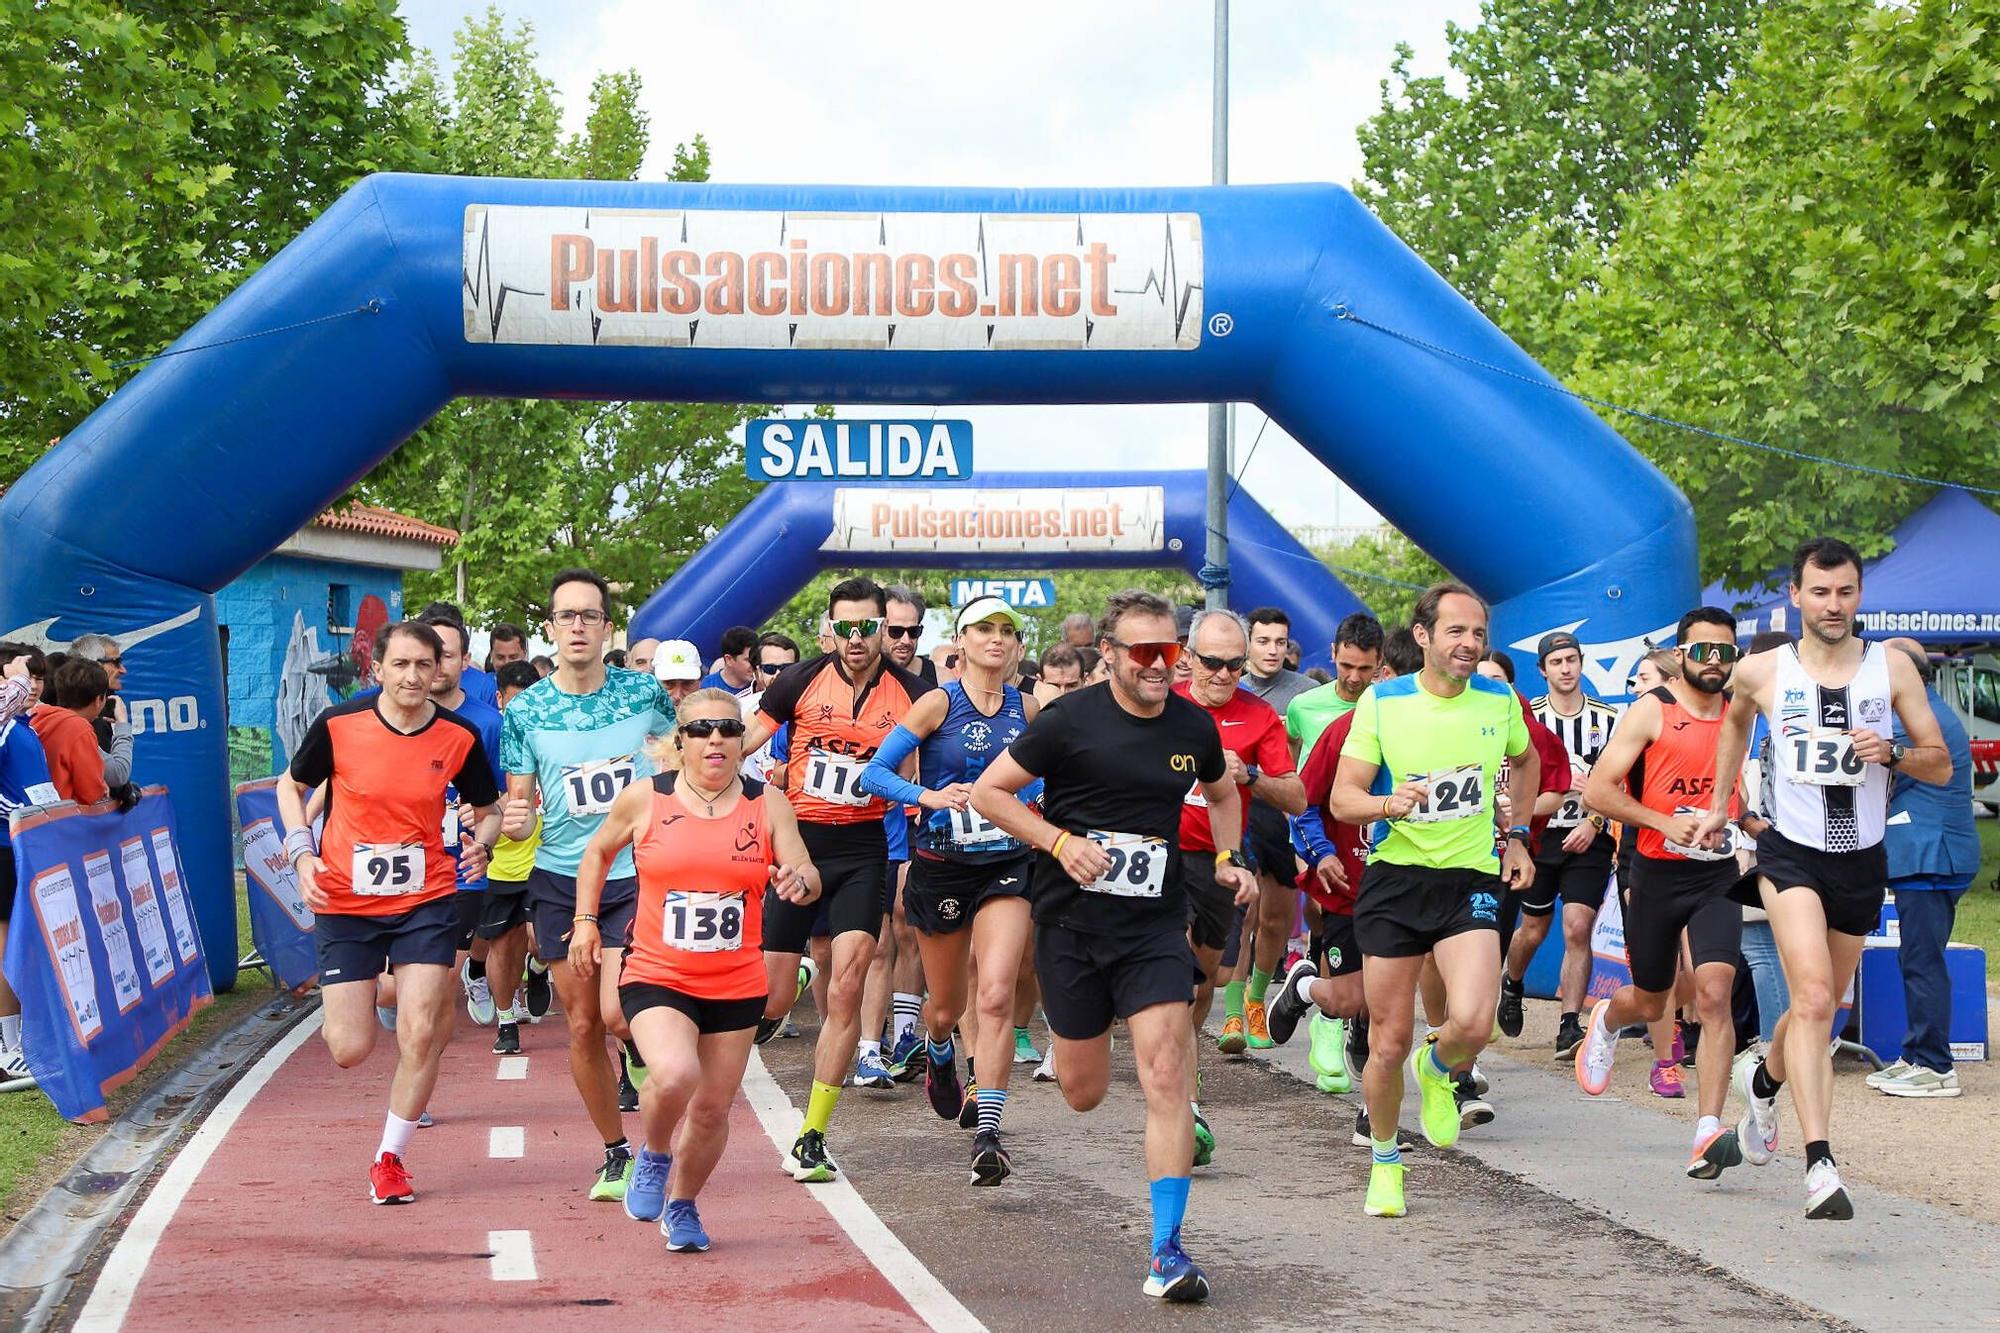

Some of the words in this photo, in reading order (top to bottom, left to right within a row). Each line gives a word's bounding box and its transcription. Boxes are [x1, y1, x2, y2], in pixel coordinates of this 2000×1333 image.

[549, 232, 1118, 319] Pulsaciones.net
[760, 422, 960, 477] SALIDA
[870, 502, 1125, 539] Pulsaciones.net
[957, 579, 1047, 606] META
[1794, 739, 1864, 776] 136
[570, 768, 632, 806] 107
[367, 855, 411, 886] 95
[1104, 847, 1151, 885] 98
[672, 905, 741, 941] 138
